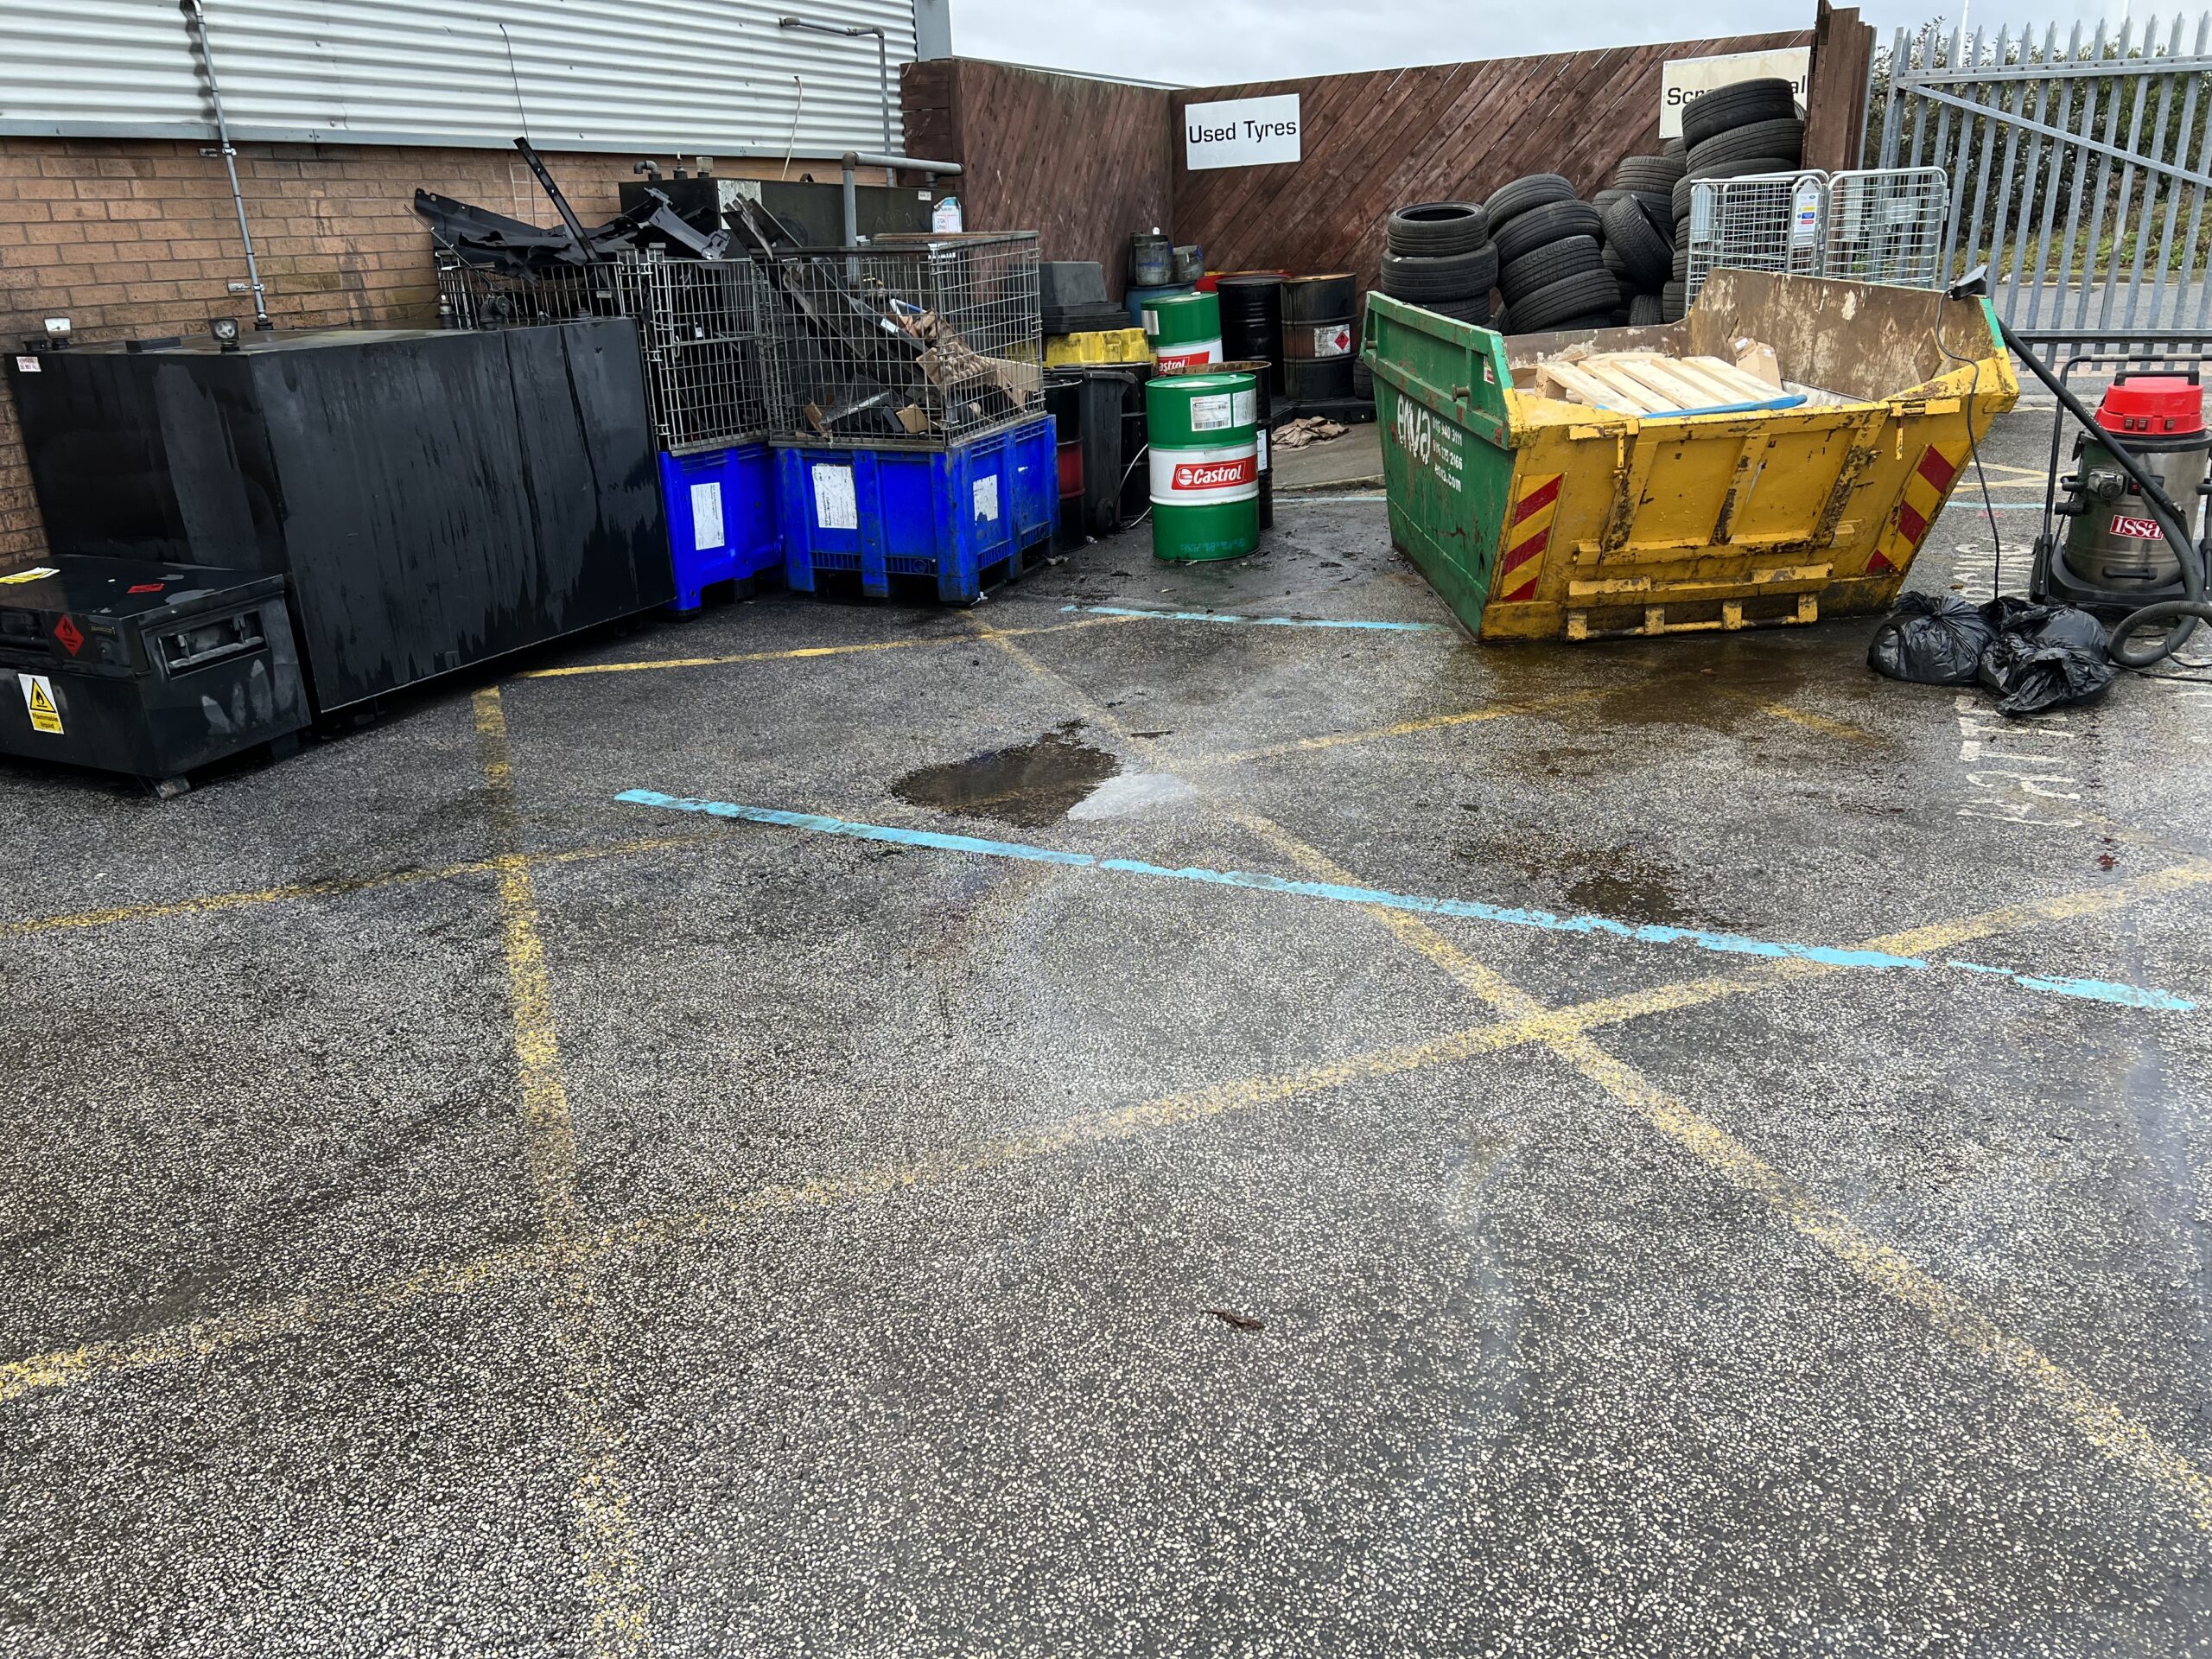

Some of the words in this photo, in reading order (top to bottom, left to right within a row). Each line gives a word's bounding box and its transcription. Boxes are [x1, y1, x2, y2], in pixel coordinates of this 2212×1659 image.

[1667, 86, 1715, 105] Scr
[1189, 122, 1236, 143] Used
[1243, 120, 1296, 143] Tyres
[1159, 359, 1185, 372] astrol
[1397, 394, 1431, 465] enva
[1450, 452, 1463, 470] 2166
[1193, 464, 1242, 485] Castrol
[2113, 516, 2163, 538] issa
